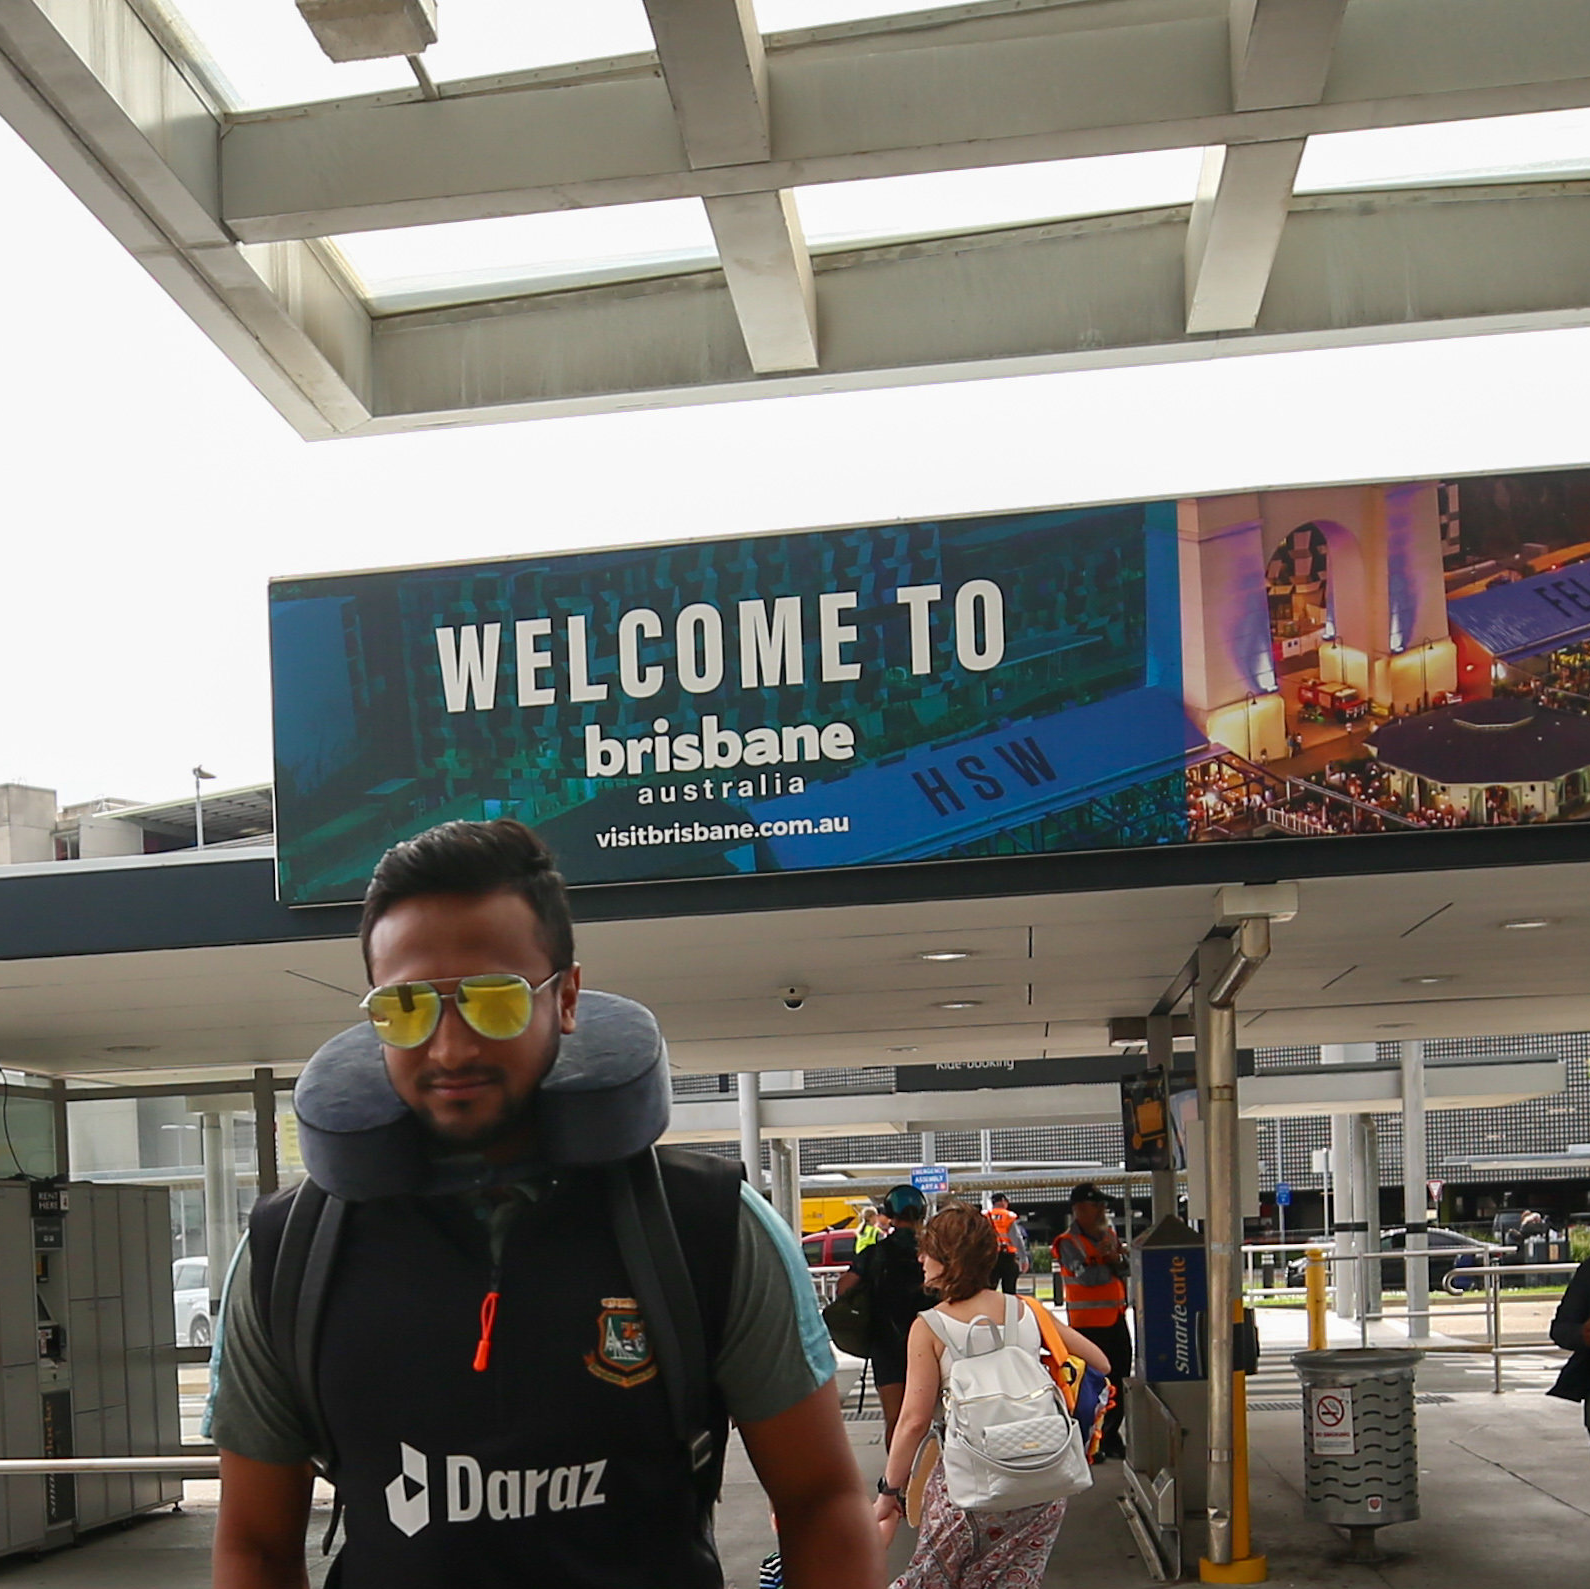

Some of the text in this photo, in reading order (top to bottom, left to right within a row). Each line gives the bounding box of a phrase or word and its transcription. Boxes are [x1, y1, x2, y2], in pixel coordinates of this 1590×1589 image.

[434, 577, 1007, 713] WELCOME TO
[584, 714, 856, 779] brisbane
[911, 736, 1059, 817] HSW
[637, 773, 808, 806] australia
[595, 812, 850, 849] visitbrisbane.com.au
[38, 1191, 58, 1200] RENT
[1169, 1256, 1190, 1375] smartecarte
[445, 1455, 608, 1523] Daraz
